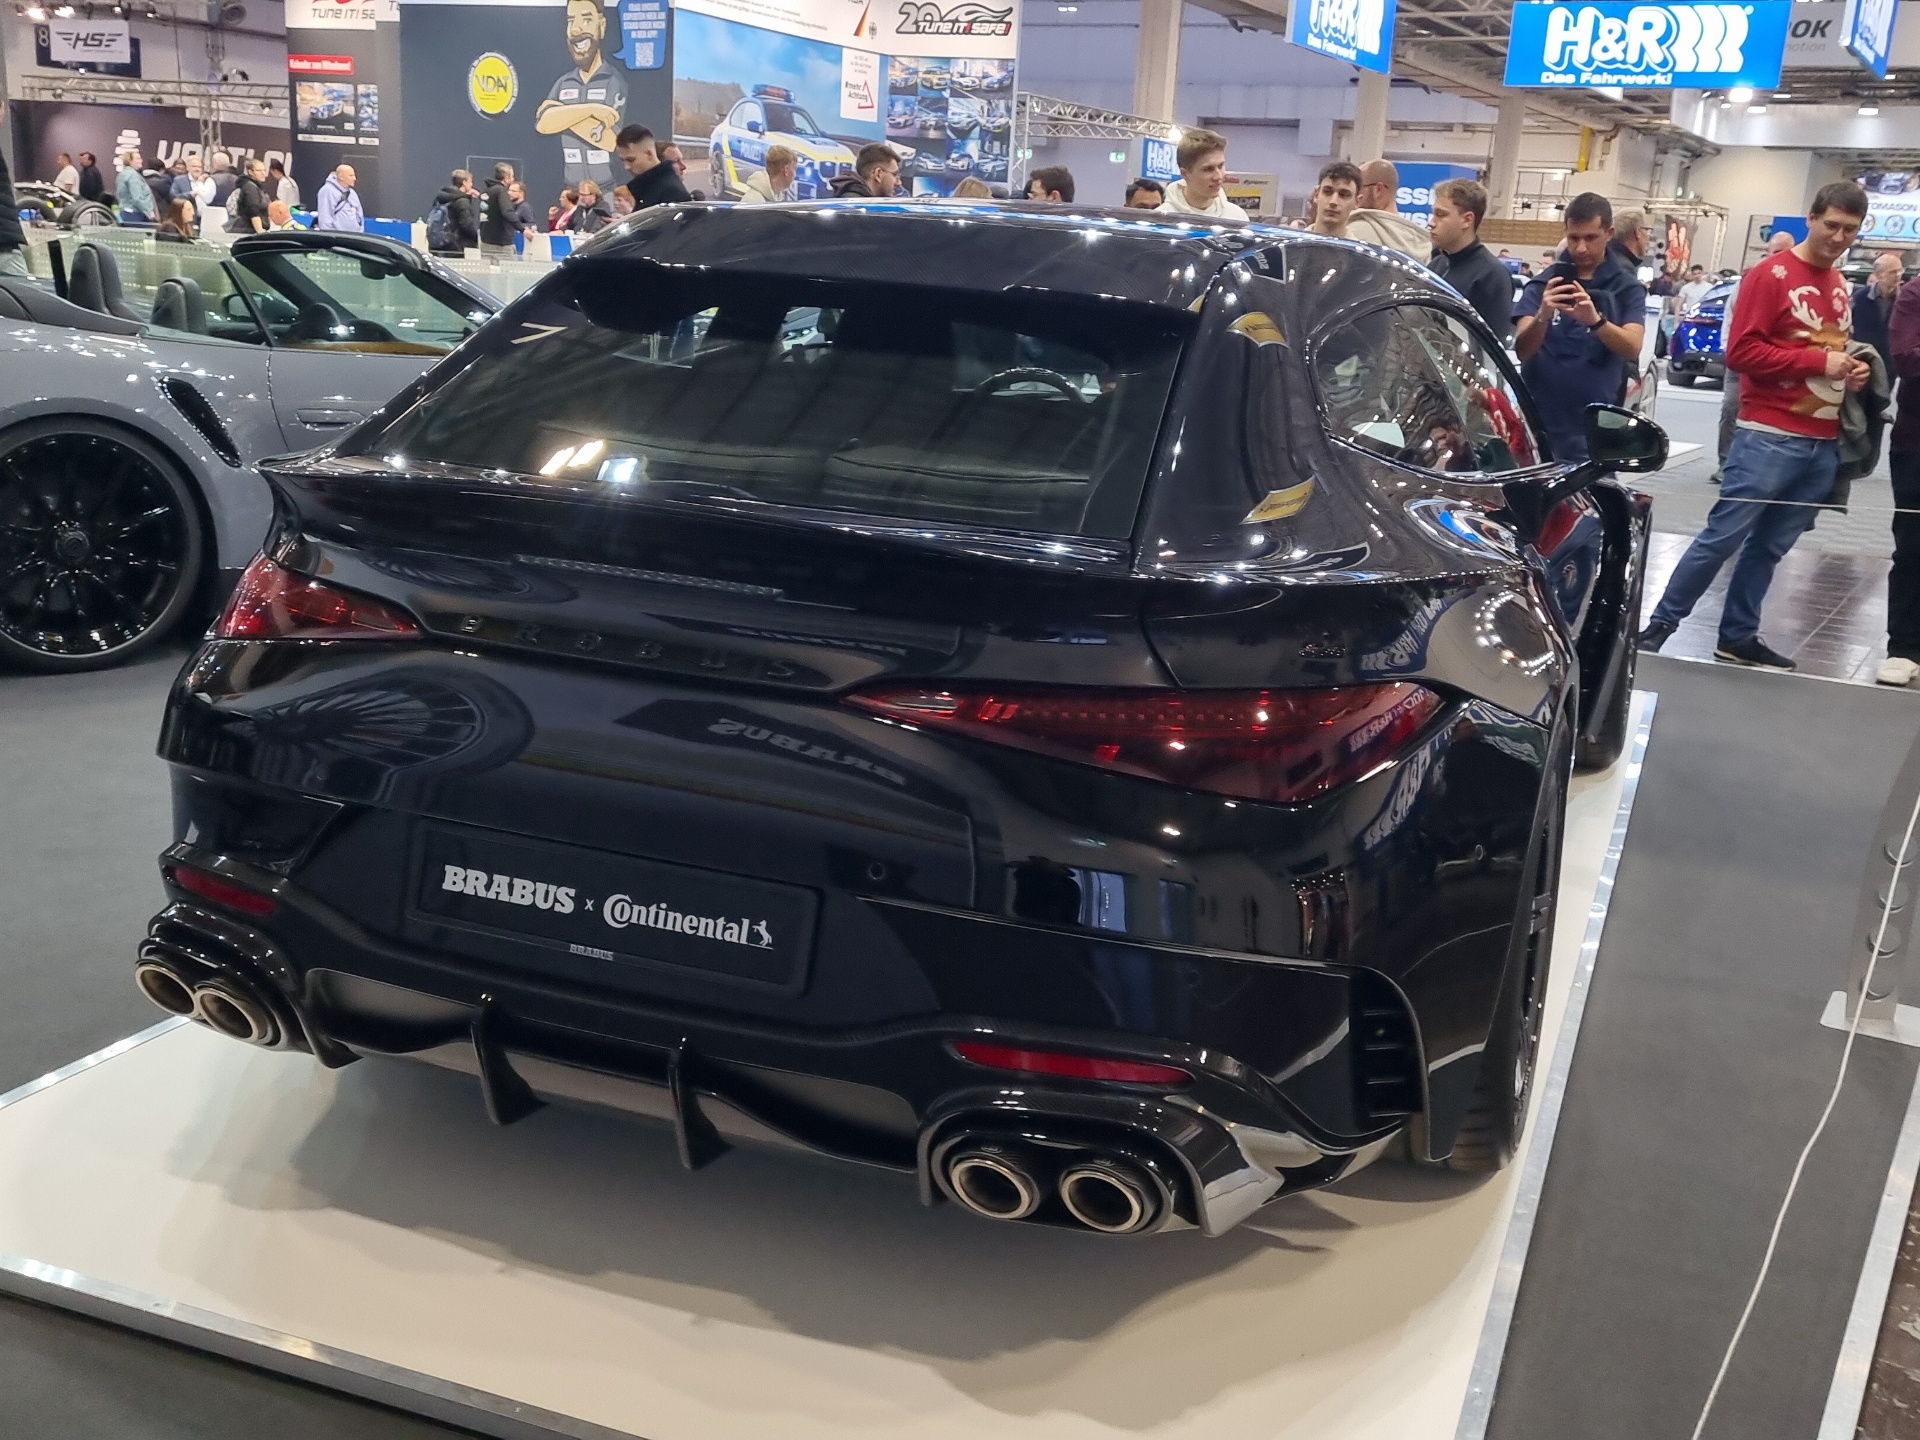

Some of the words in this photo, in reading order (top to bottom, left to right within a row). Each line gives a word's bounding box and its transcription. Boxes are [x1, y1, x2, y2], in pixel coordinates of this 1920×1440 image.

[1543, 6, 1678, 72] H&R
[1789, 20, 1833, 38] OK
[1541, 71, 1576, 84] Das
[1579, 72, 1674, 85] Fahrwerk!
[460, 614, 796, 678] BRABUS
[442, 864, 576, 914] BRABUS
[603, 893, 751, 945] Continental
[569, 943, 614, 962] BRABUS
